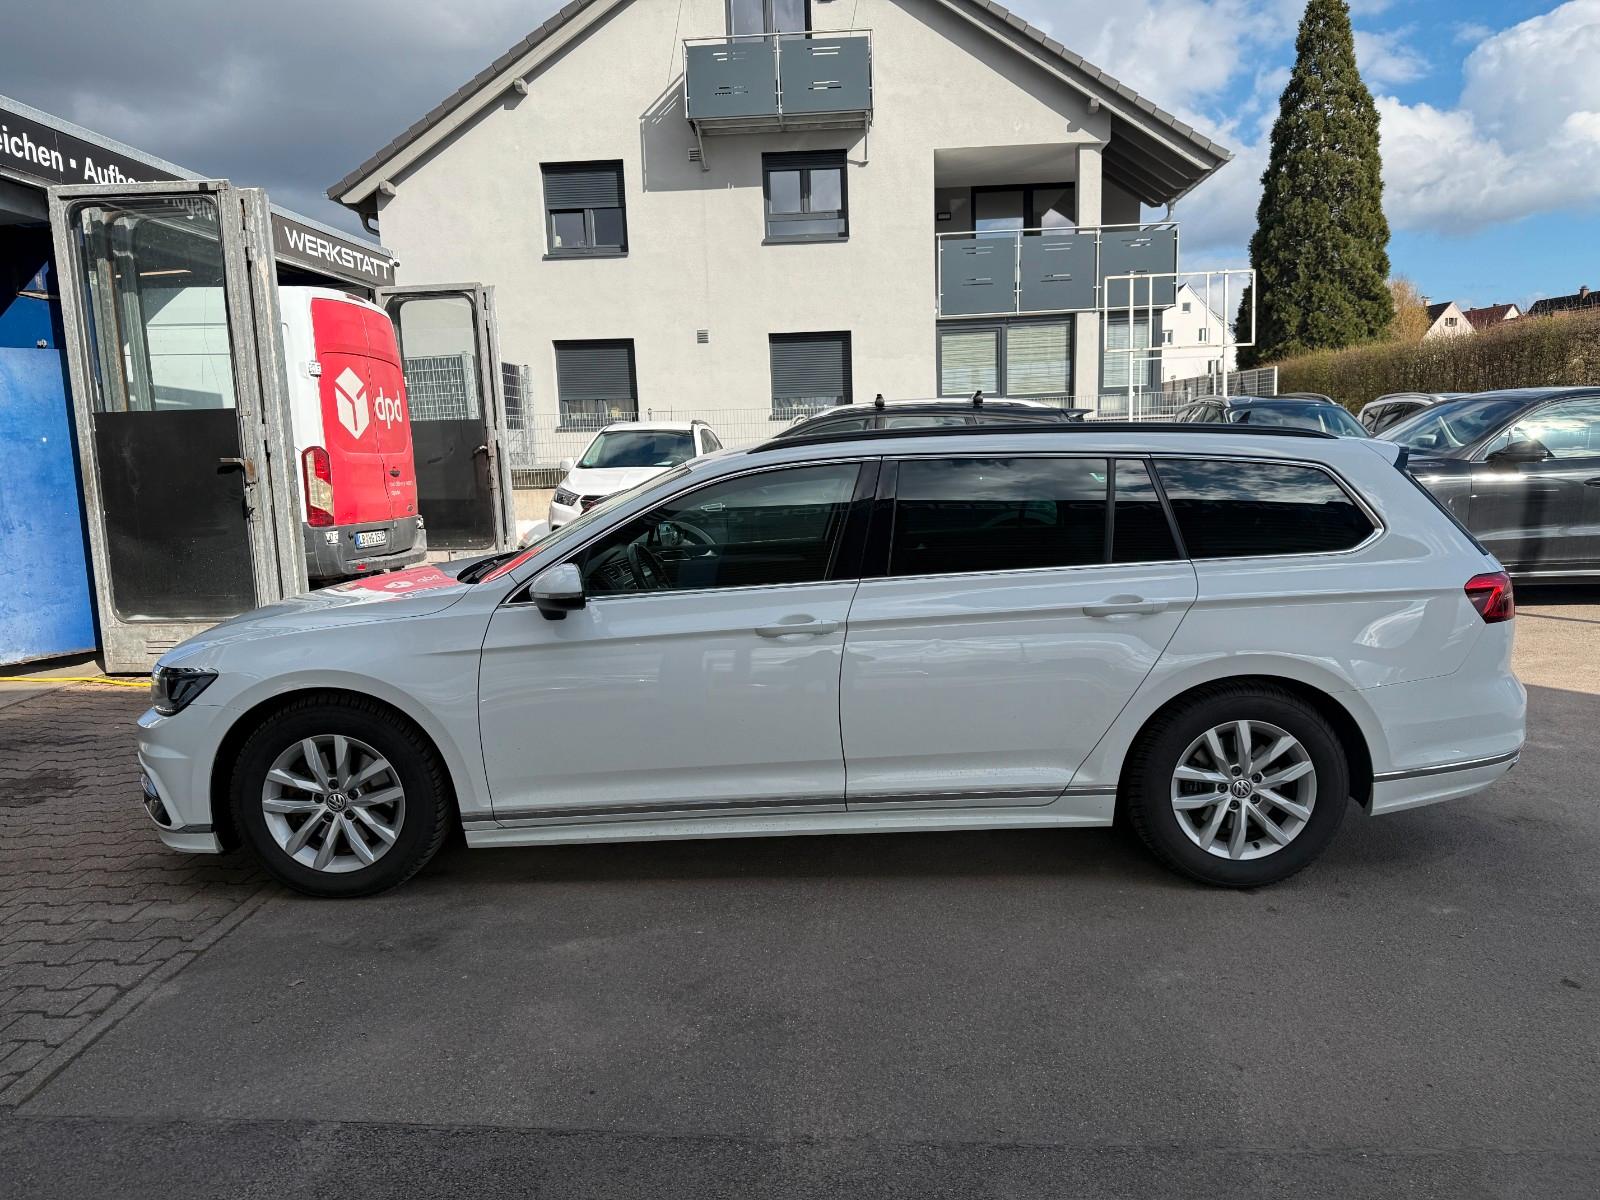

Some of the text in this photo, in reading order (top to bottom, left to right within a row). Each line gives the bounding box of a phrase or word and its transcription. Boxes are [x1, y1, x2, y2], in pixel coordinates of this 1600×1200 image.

[0, 125, 64, 172] ichen
[284, 226, 389, 279] WERKSTATT
[375, 386, 402, 430] dpd
